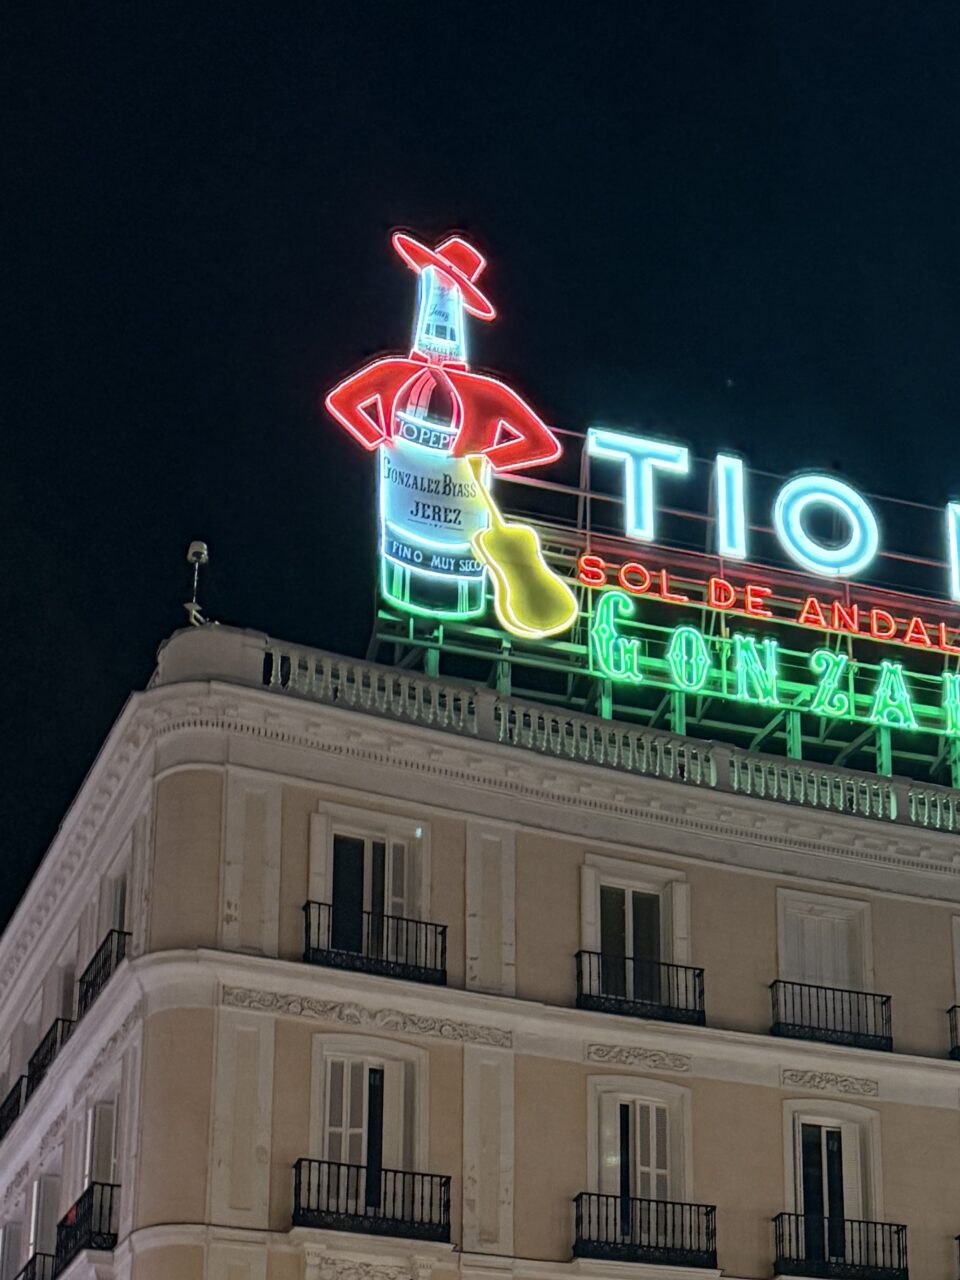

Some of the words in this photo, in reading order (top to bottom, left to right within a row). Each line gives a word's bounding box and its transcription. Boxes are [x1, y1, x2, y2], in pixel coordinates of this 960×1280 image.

[383, 456, 440, 495] GONZALEZ
[442, 473, 477, 498] BYASS
[410, 500, 462, 525] JEREZ
[587, 427, 880, 576] TIO
[392, 540, 423, 563] FINO
[431, 556, 456, 571] MUY
[578, 555, 689, 602] SOL
[708, 577, 772, 617] DE
